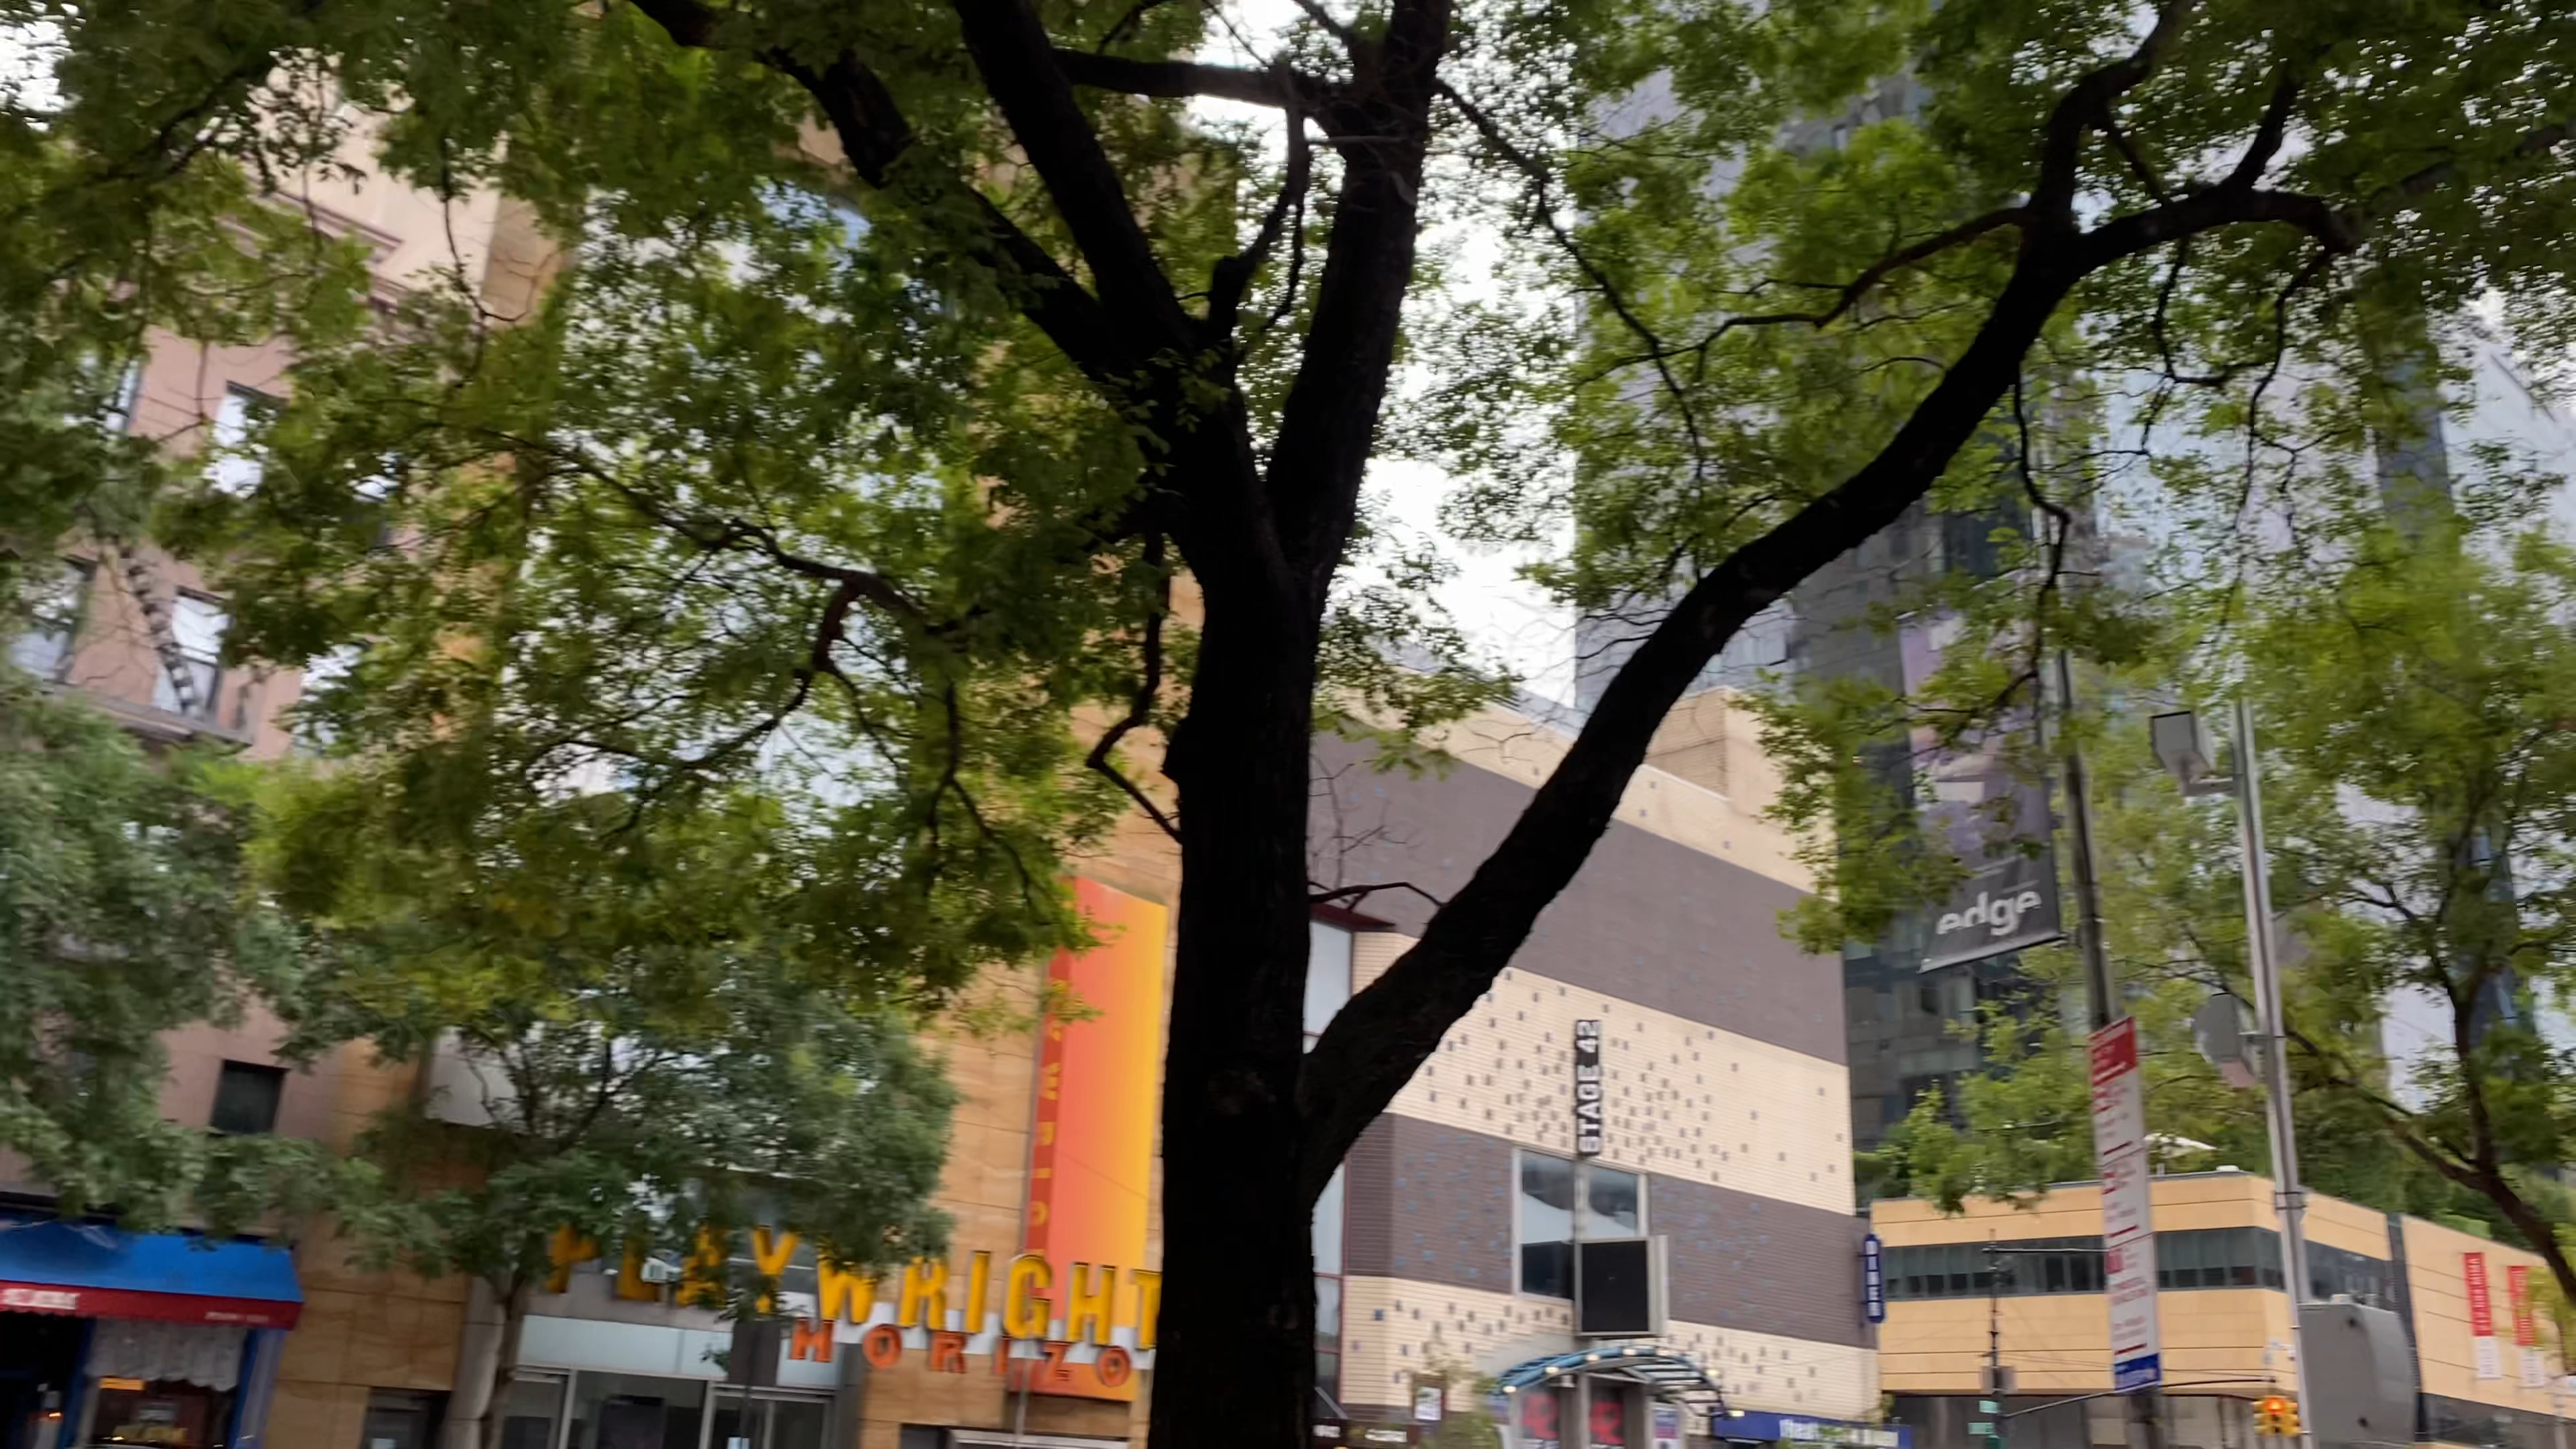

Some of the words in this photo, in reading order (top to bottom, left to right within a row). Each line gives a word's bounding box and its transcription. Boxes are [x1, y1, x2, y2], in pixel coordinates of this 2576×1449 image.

[1936, 891, 2042, 936] edge
[1576, 1020, 1600, 1053] 42
[1576, 1064, 1601, 1152] STAGE
